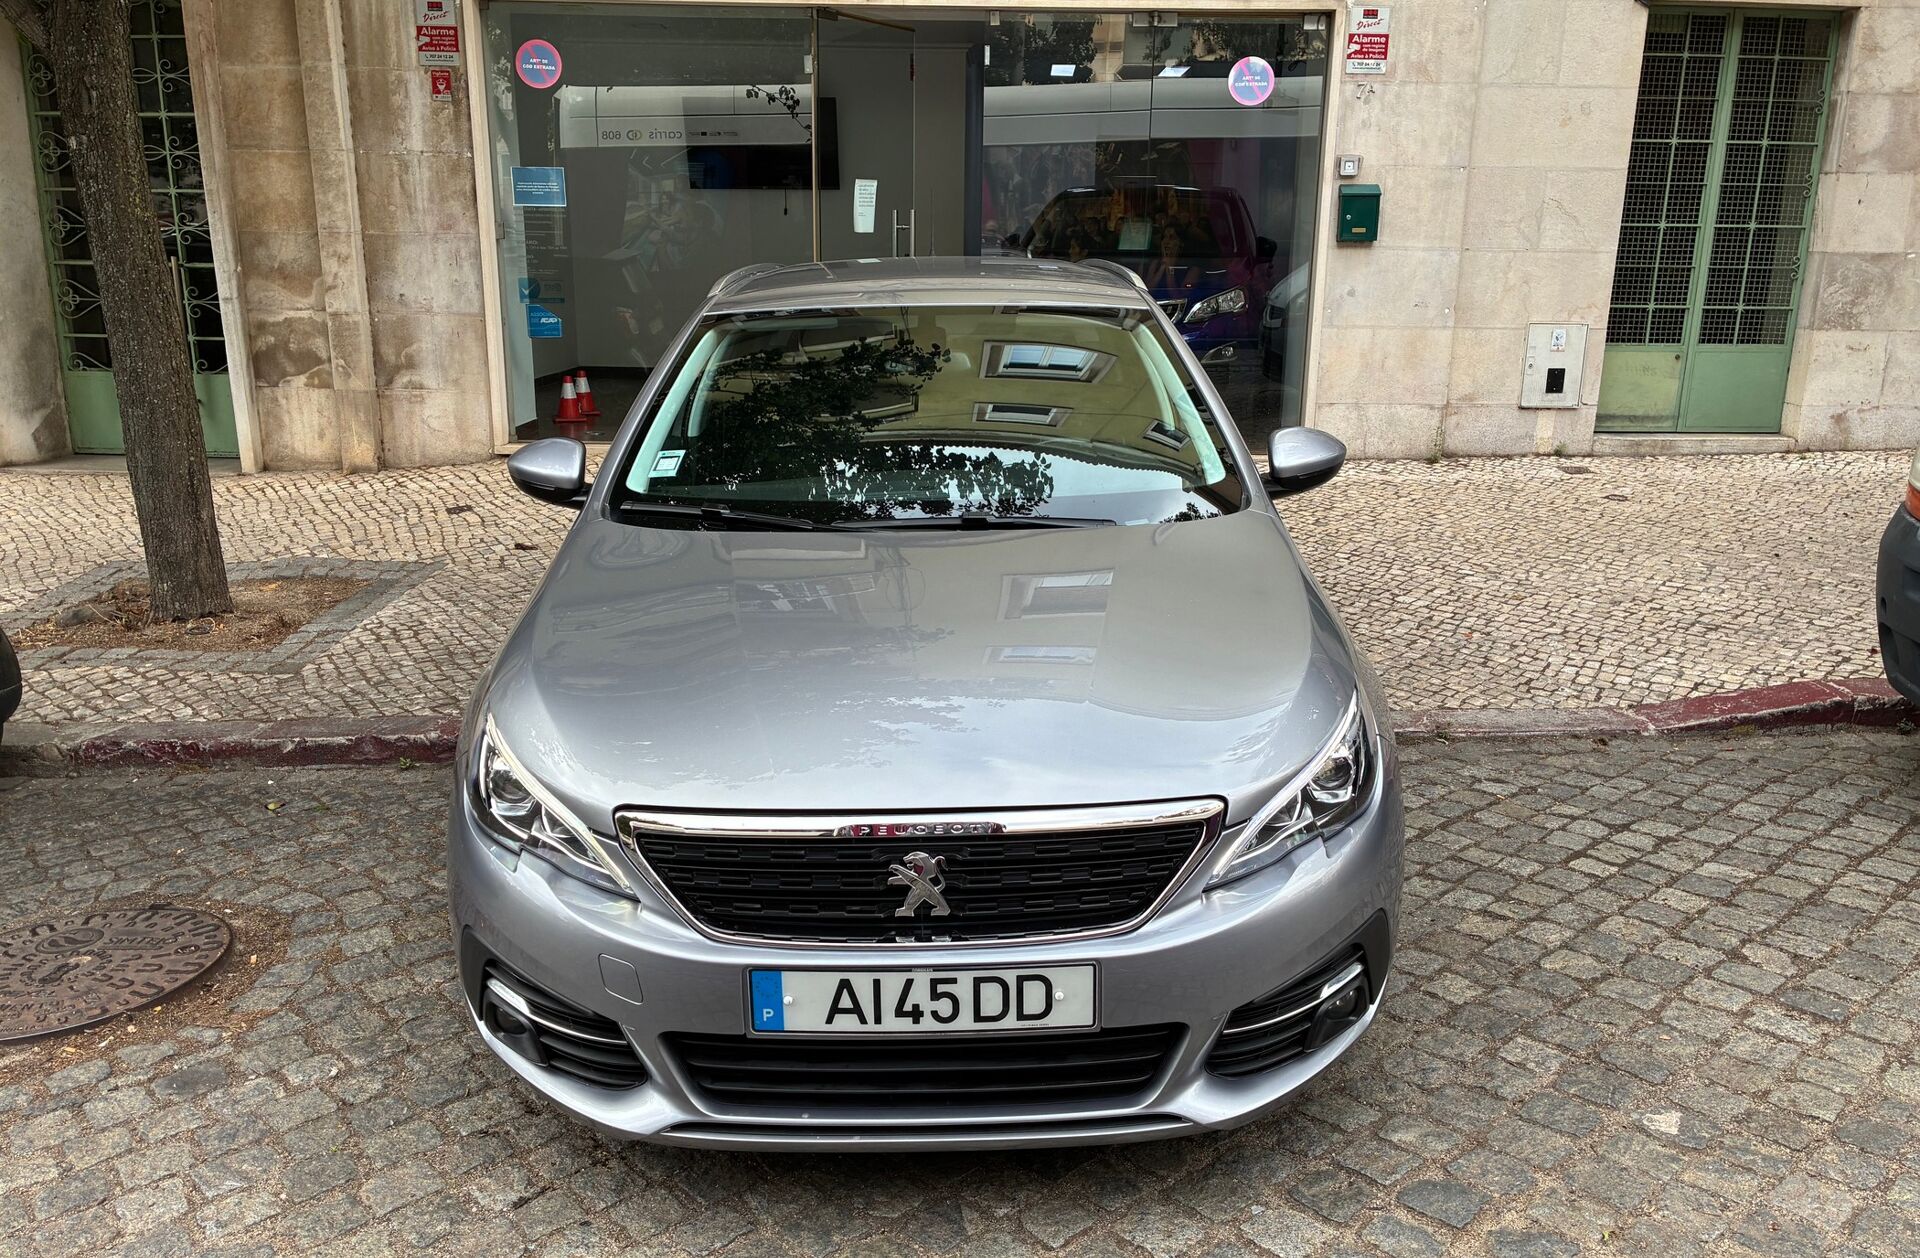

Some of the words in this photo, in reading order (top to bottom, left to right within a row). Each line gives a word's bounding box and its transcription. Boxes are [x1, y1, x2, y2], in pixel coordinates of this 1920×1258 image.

[421, 27, 455, 36] Alarme
[1352, 35, 1386, 43] Alarme
[858, 824, 982, 836] PEUGEOT
[763, 1009, 774, 1022] P
